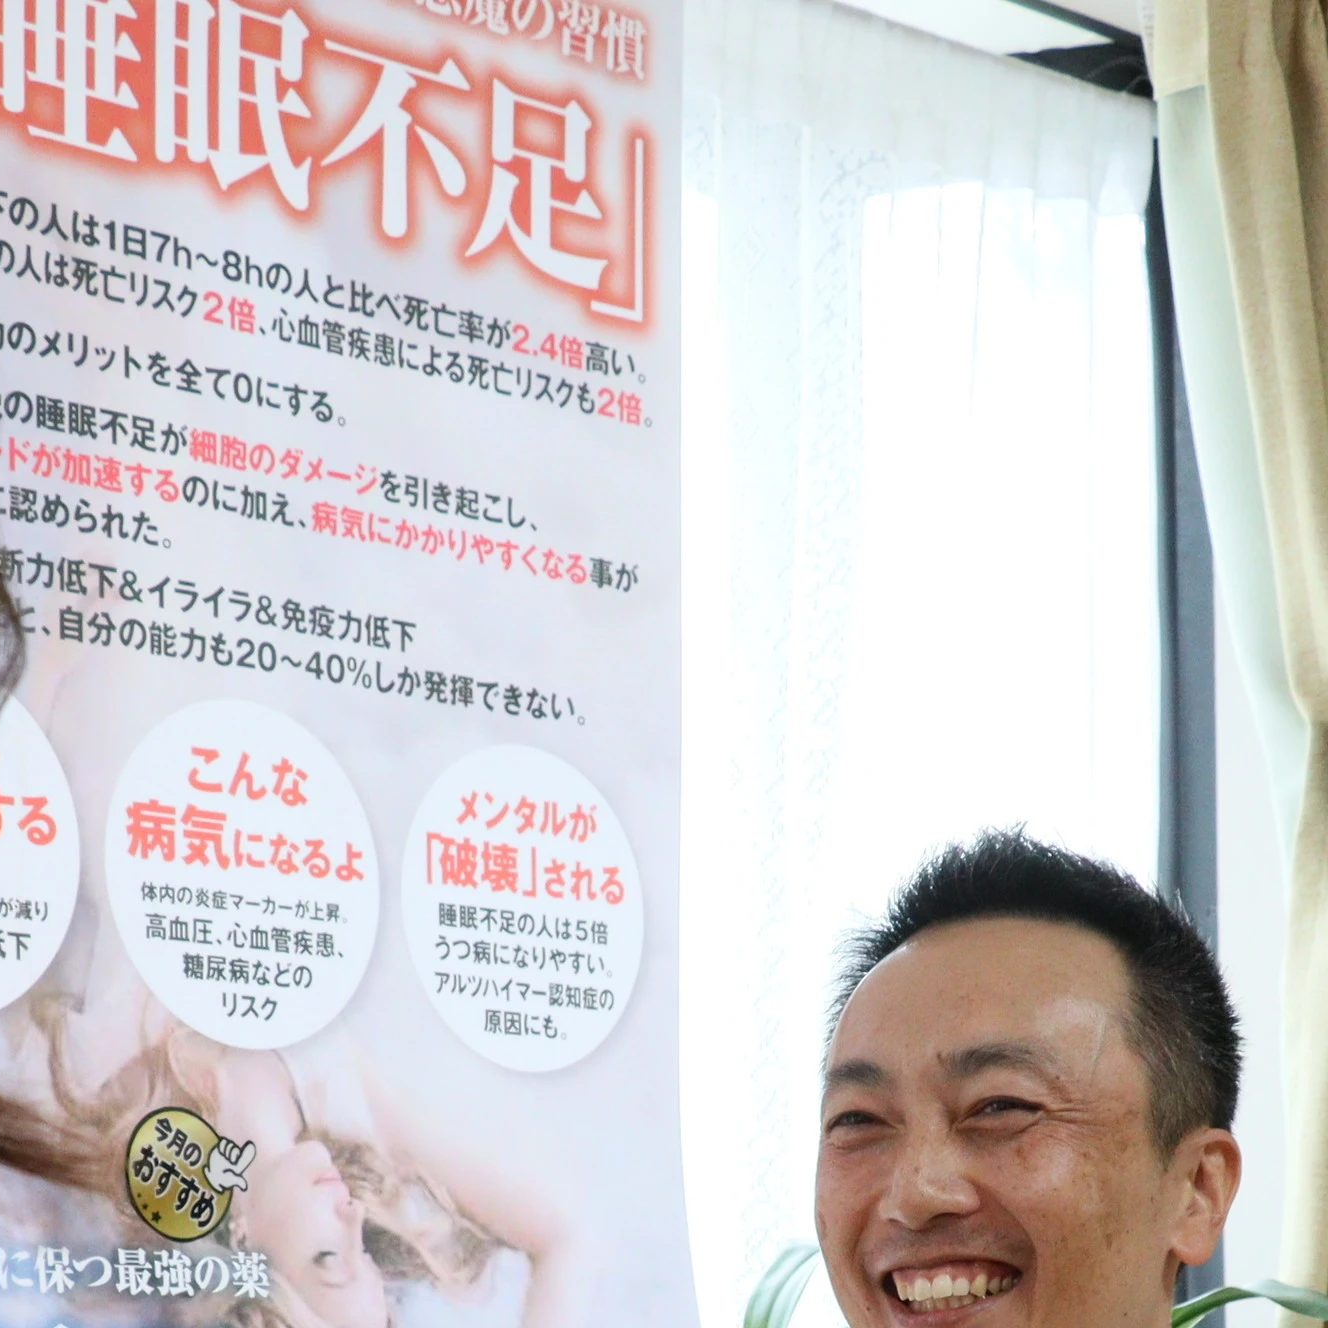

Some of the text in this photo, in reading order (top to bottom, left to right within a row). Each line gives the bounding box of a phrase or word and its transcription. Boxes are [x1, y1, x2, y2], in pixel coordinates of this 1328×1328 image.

[187, 745, 309, 807] こんな
[456, 790, 597, 843] メンタルが
[125, 798, 365, 882] 病気になるよ
[426, 831, 625, 906] 「破壊」される
[141, 881, 348, 924] 体内の炎症マーカーが上昇。
[438, 902, 608, 945] 睡眠不足の人は5倍
[144, 912, 346, 959] 高血圧、心血管疾患、
[435, 935, 613, 979] うつ病になりやすい。
[183, 952, 313, 989] 糖尿病などの
[434, 971, 614, 1012] アルツハイマー認知症の
[222, 992, 278, 1021] リスク
[484, 1009, 568, 1041] 原因にも。
[155, 1117, 203, 1167] 今月の
[133, 1143, 215, 1228] おすすめ
